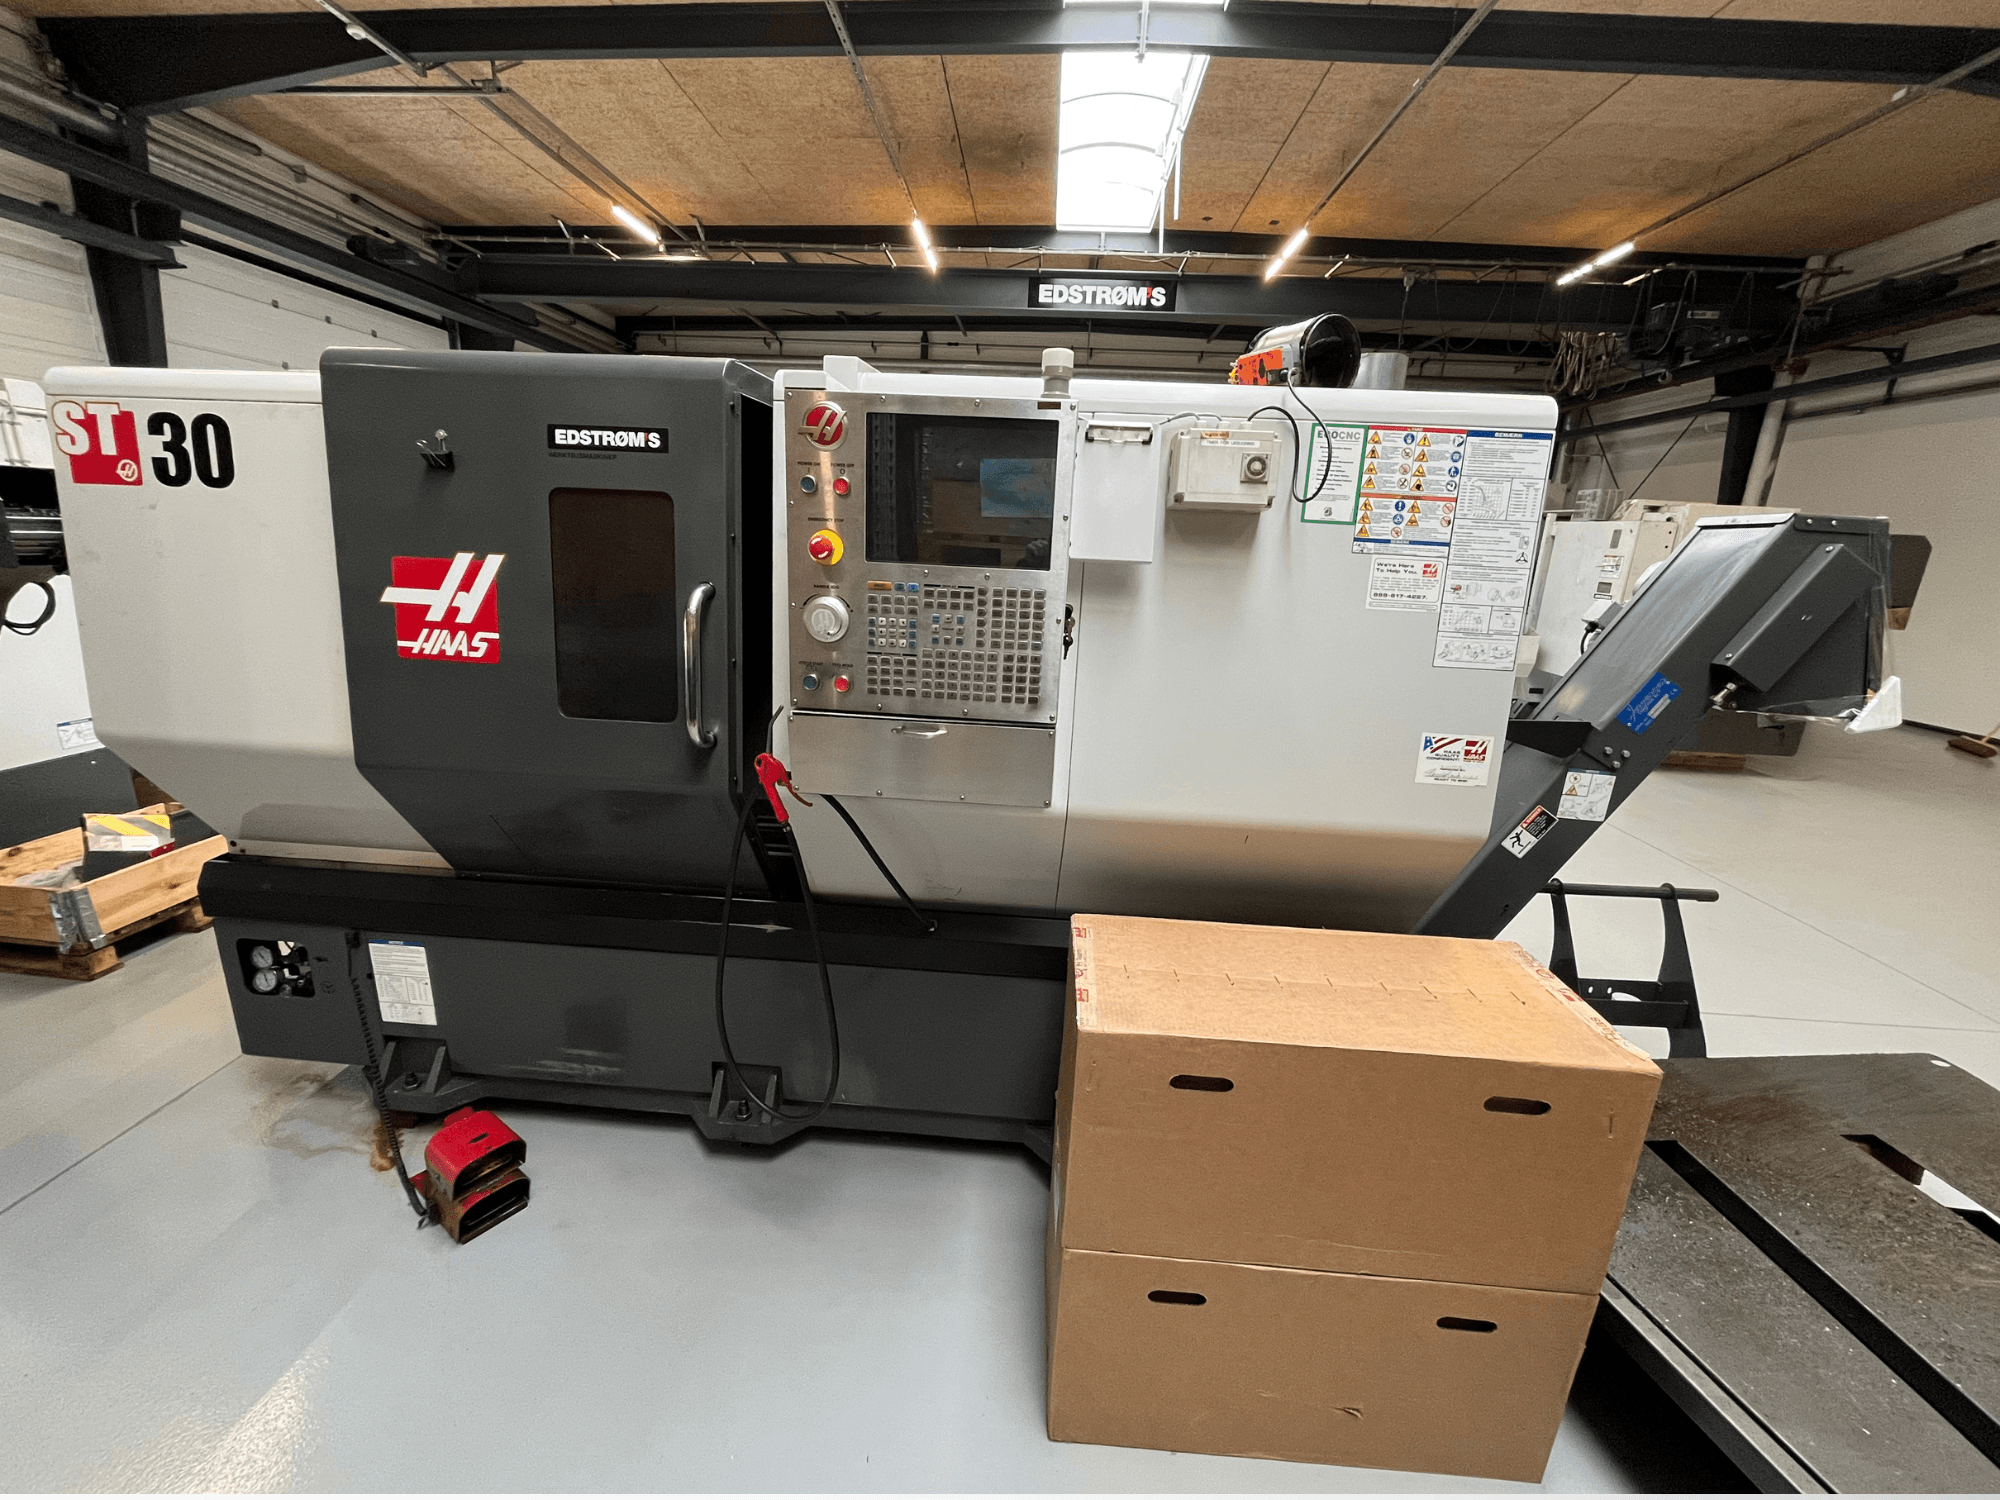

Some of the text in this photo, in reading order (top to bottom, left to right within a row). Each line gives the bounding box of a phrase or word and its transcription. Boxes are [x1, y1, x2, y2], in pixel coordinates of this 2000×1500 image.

[1038, 283, 1167, 307] EDSTRØM'S
[52, 400, 236, 489] ST 30
[554, 428, 661, 448] EDSTRØM'S
[397, 628, 500, 658] HAAS
